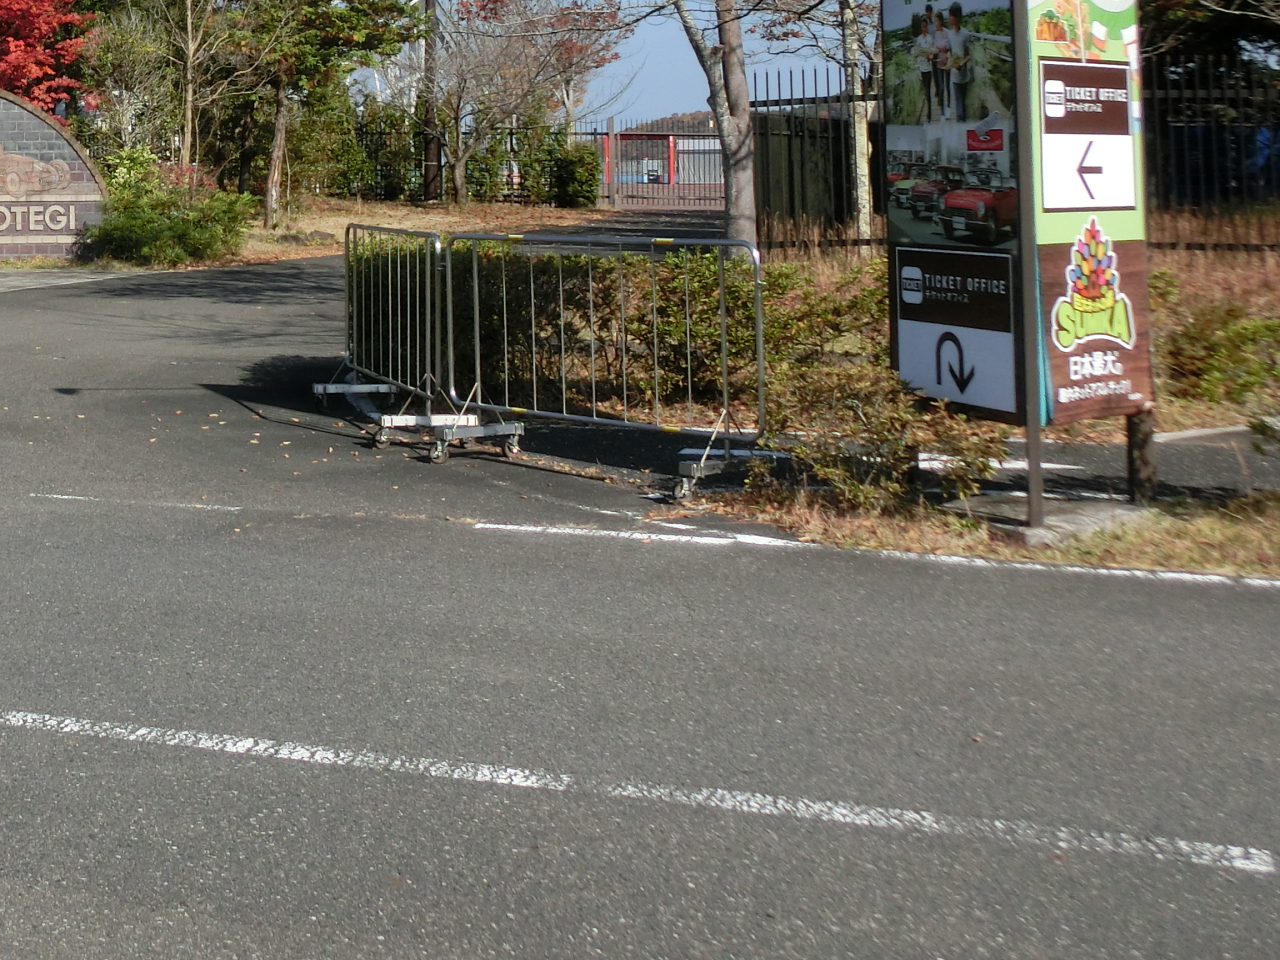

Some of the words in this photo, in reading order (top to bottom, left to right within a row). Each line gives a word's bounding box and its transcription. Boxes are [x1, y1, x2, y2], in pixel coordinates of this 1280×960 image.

[1065, 86, 1097, 100] TICKET
[1098, 88, 1128, 102] OFFICE
[924, 273, 962, 289] TICKET
[966, 278, 1006, 294] OFFICE
